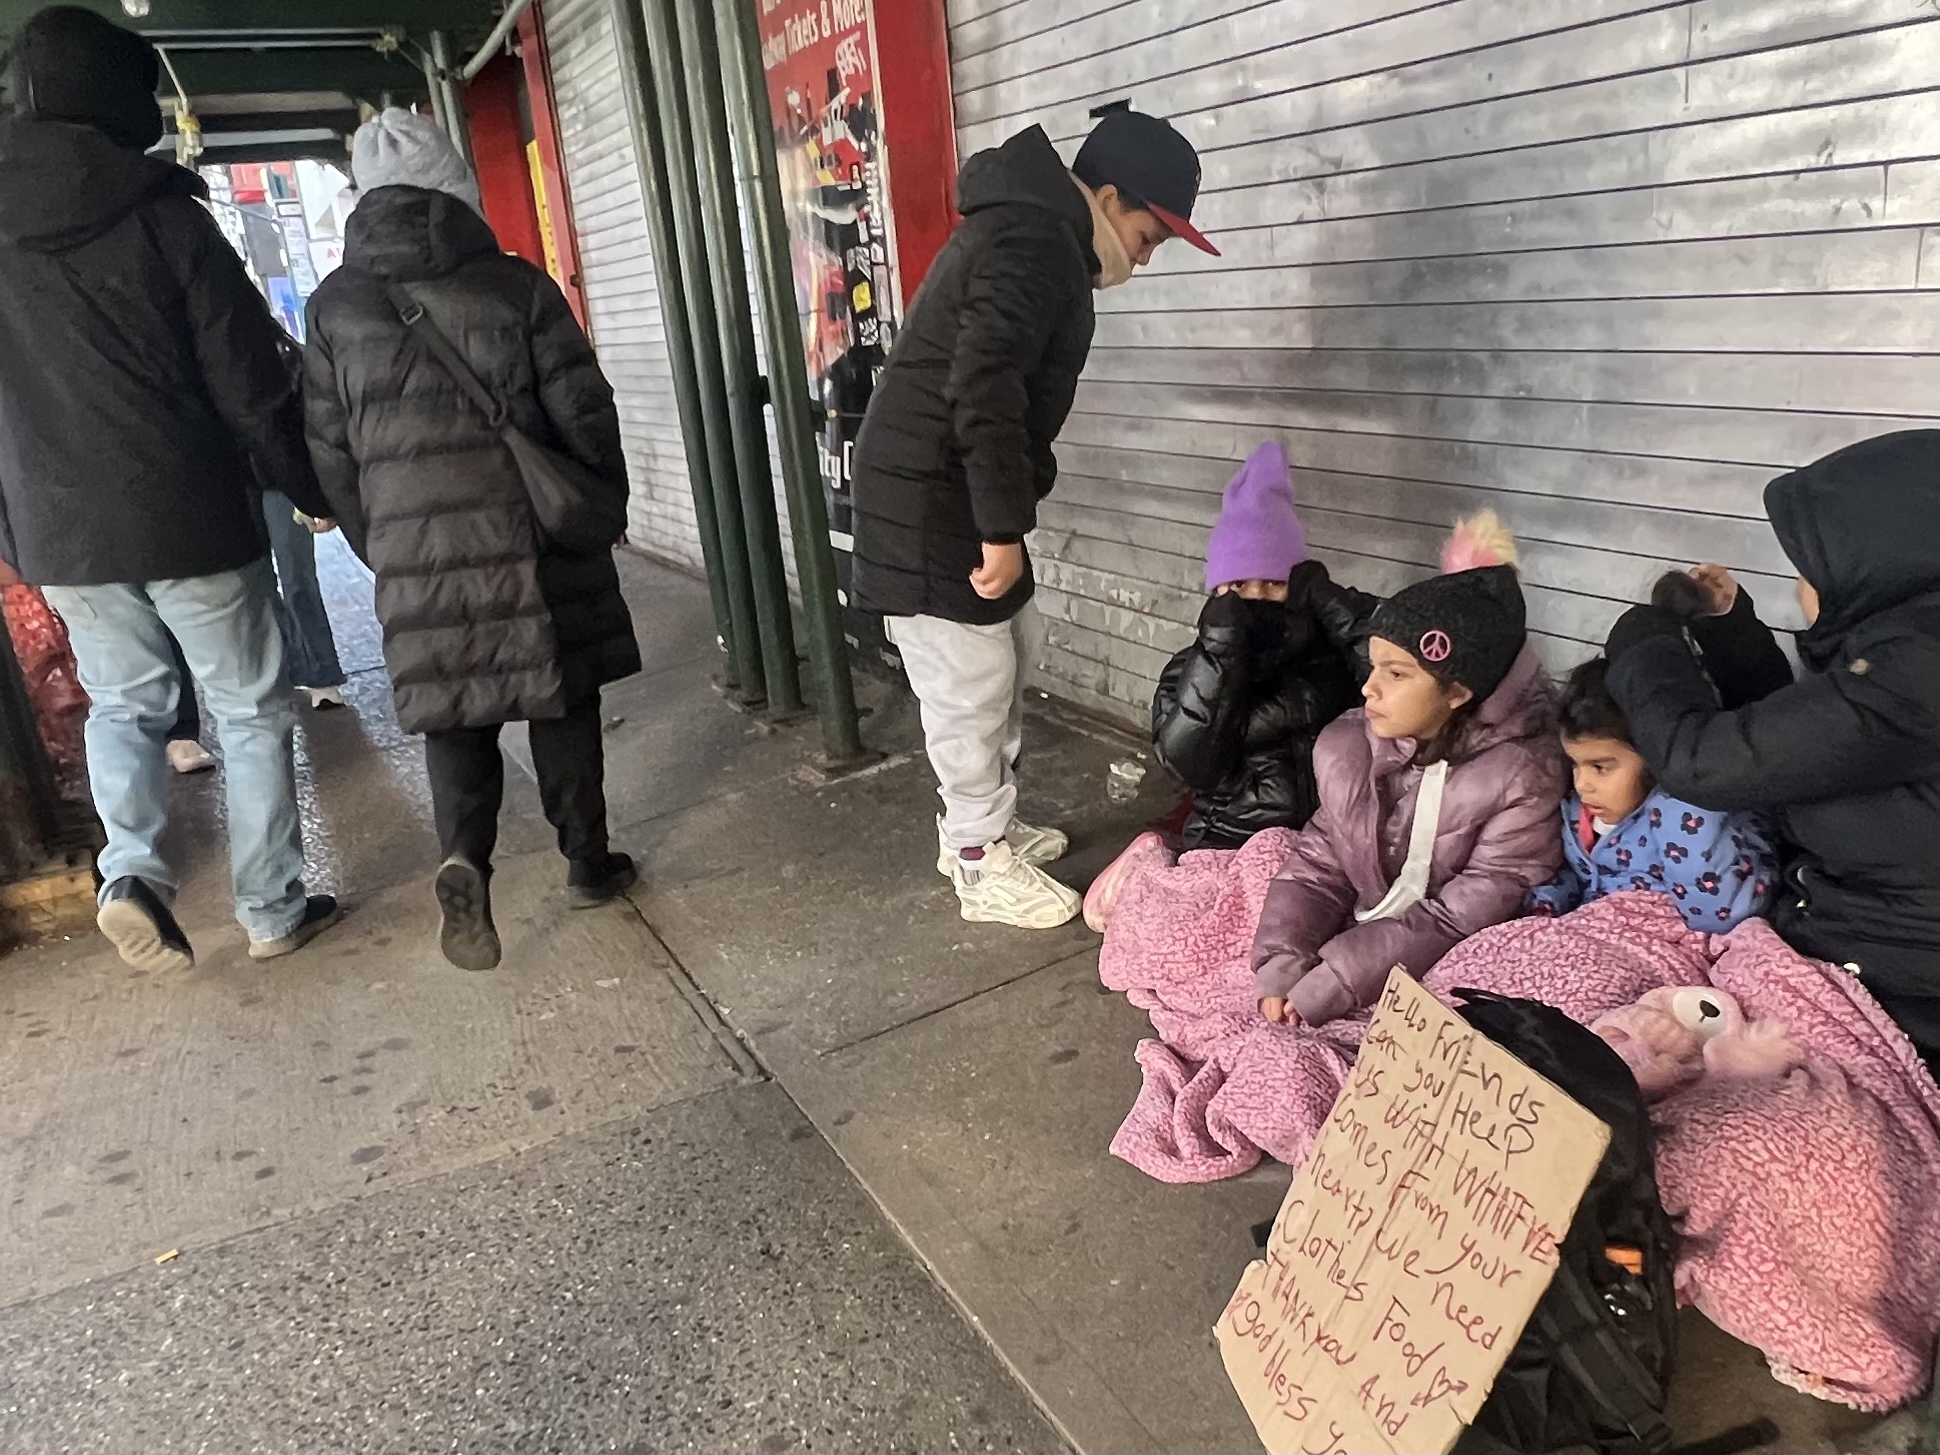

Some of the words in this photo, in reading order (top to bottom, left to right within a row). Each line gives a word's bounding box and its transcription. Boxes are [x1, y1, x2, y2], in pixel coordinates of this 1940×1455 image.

[820, 0, 831, 38] &
[1382, 976, 1427, 1032] Hello
[1402, 1060, 1446, 1098] you
[1423, 1232, 1522, 1289] your
[1372, 1293, 1445, 1378] Food
